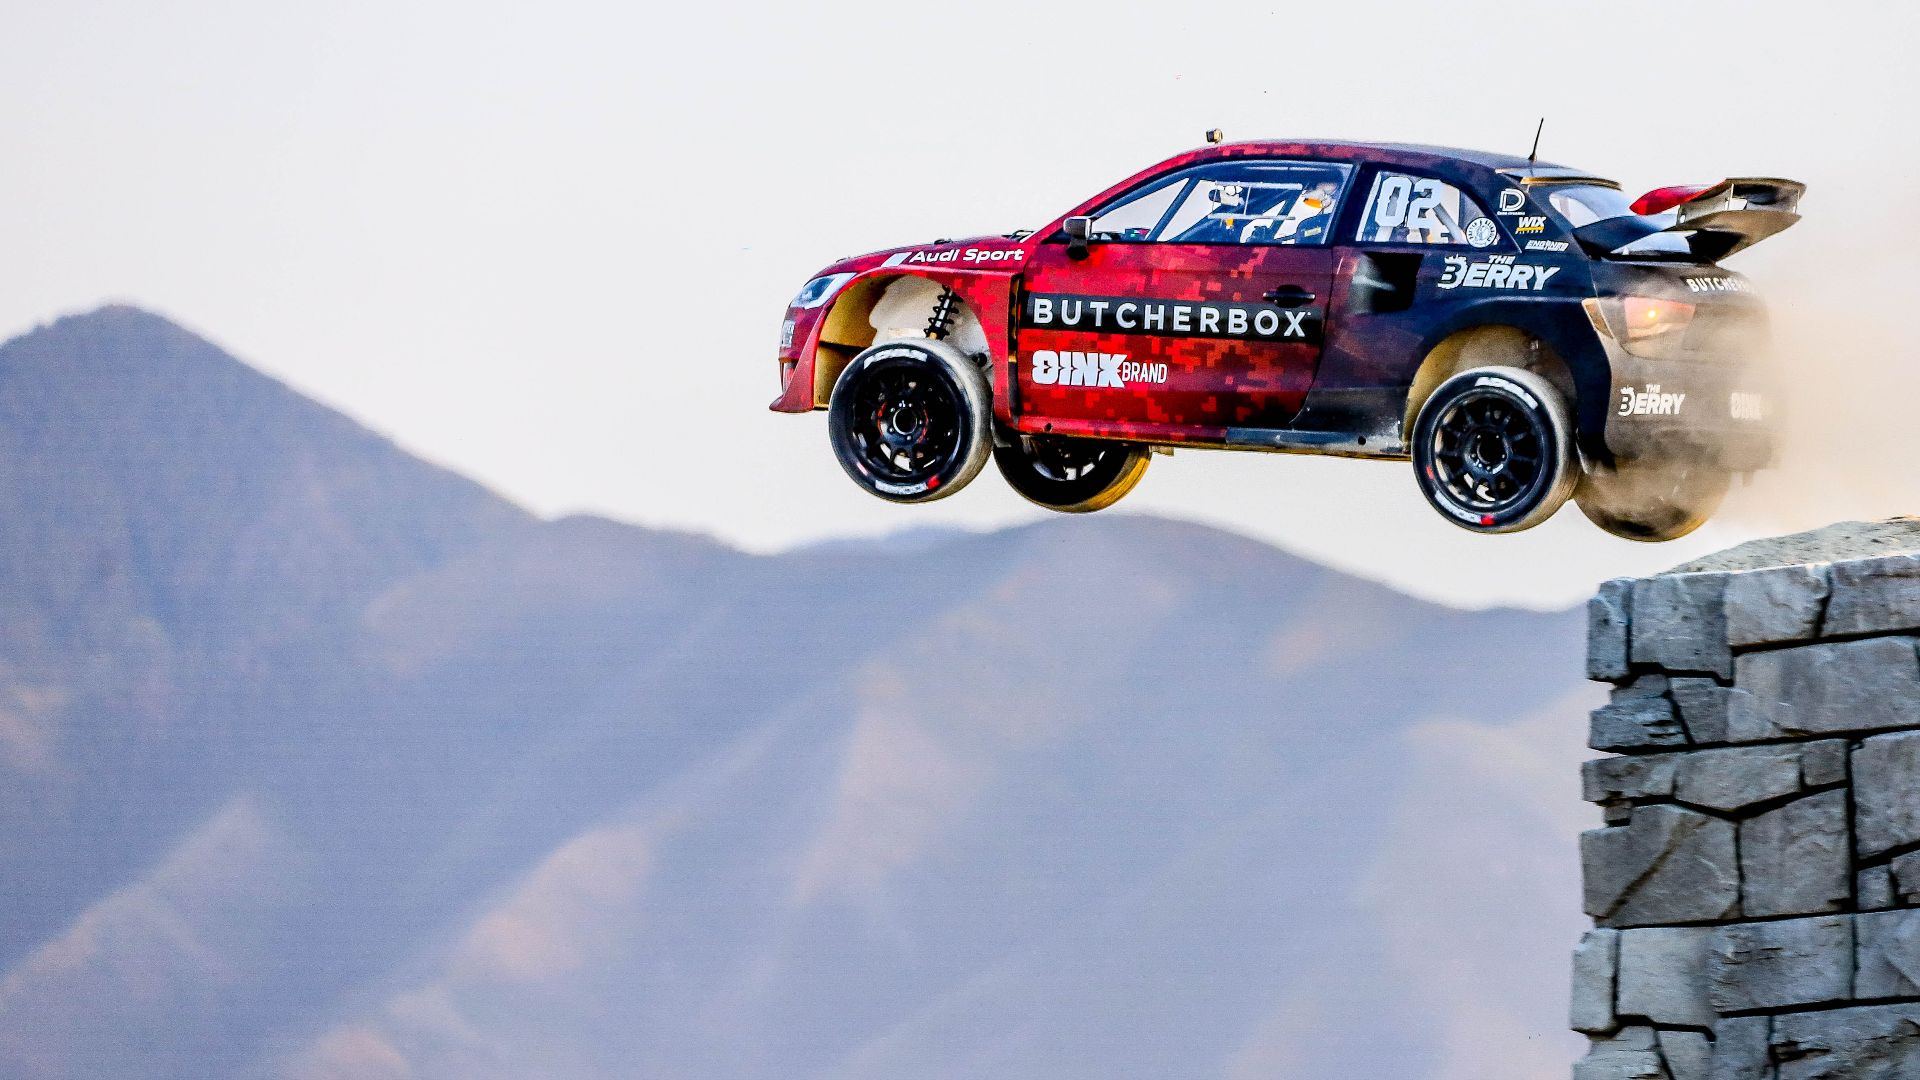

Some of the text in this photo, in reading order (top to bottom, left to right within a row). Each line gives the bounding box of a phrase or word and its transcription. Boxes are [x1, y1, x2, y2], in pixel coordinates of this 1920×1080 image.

[1375, 176, 1442, 230] 02
[1518, 216, 1547, 228] WIX
[909, 248, 1025, 264] Audi Sport
[1488, 254, 1516, 265] THE
[1437, 253, 1561, 291] BERRY
[1033, 298, 1306, 338] BUTCHERBOX
[1122, 360, 1168, 385] BRAND
[1617, 385, 1686, 417] BERRY
[1645, 383, 1661, 394] THE
